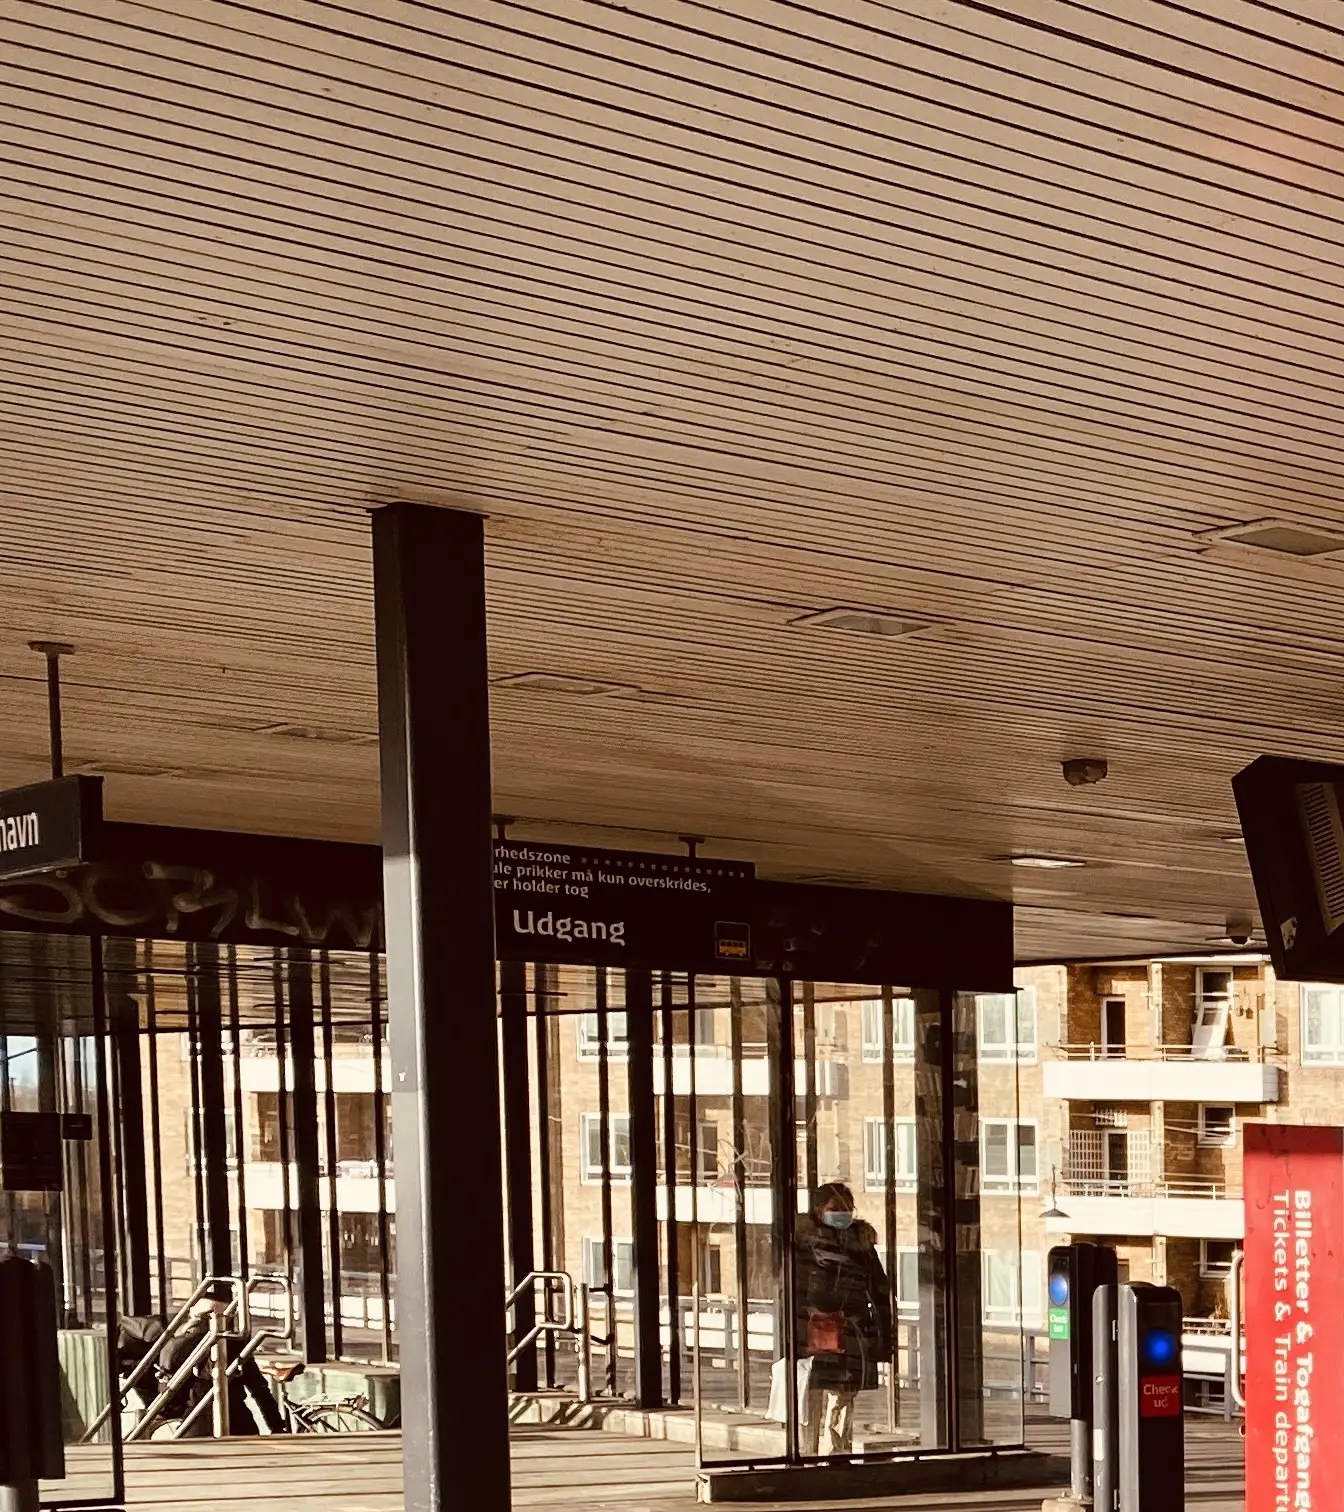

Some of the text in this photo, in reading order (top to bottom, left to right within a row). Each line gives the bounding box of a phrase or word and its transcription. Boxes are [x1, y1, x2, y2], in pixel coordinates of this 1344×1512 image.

[513, 880, 560, 895] holder
[565, 884, 590, 899] tog
[516, 866, 568, 881] prikker
[572, 870, 594, 883] må
[597, 871, 625, 885] kun
[628, 875, 712, 894] overskrides,
[512, 909, 626, 947] Udgang
[1272, 1188, 1291, 1293] Tickets
[1294, 1189, 1313, 1314] Billetter
[1274, 1301, 1292, 1323] &
[1295, 1320, 1314, 1344] &
[1273, 1334, 1292, 1402] Train
[1143, 1383, 1179, 1396] Check
